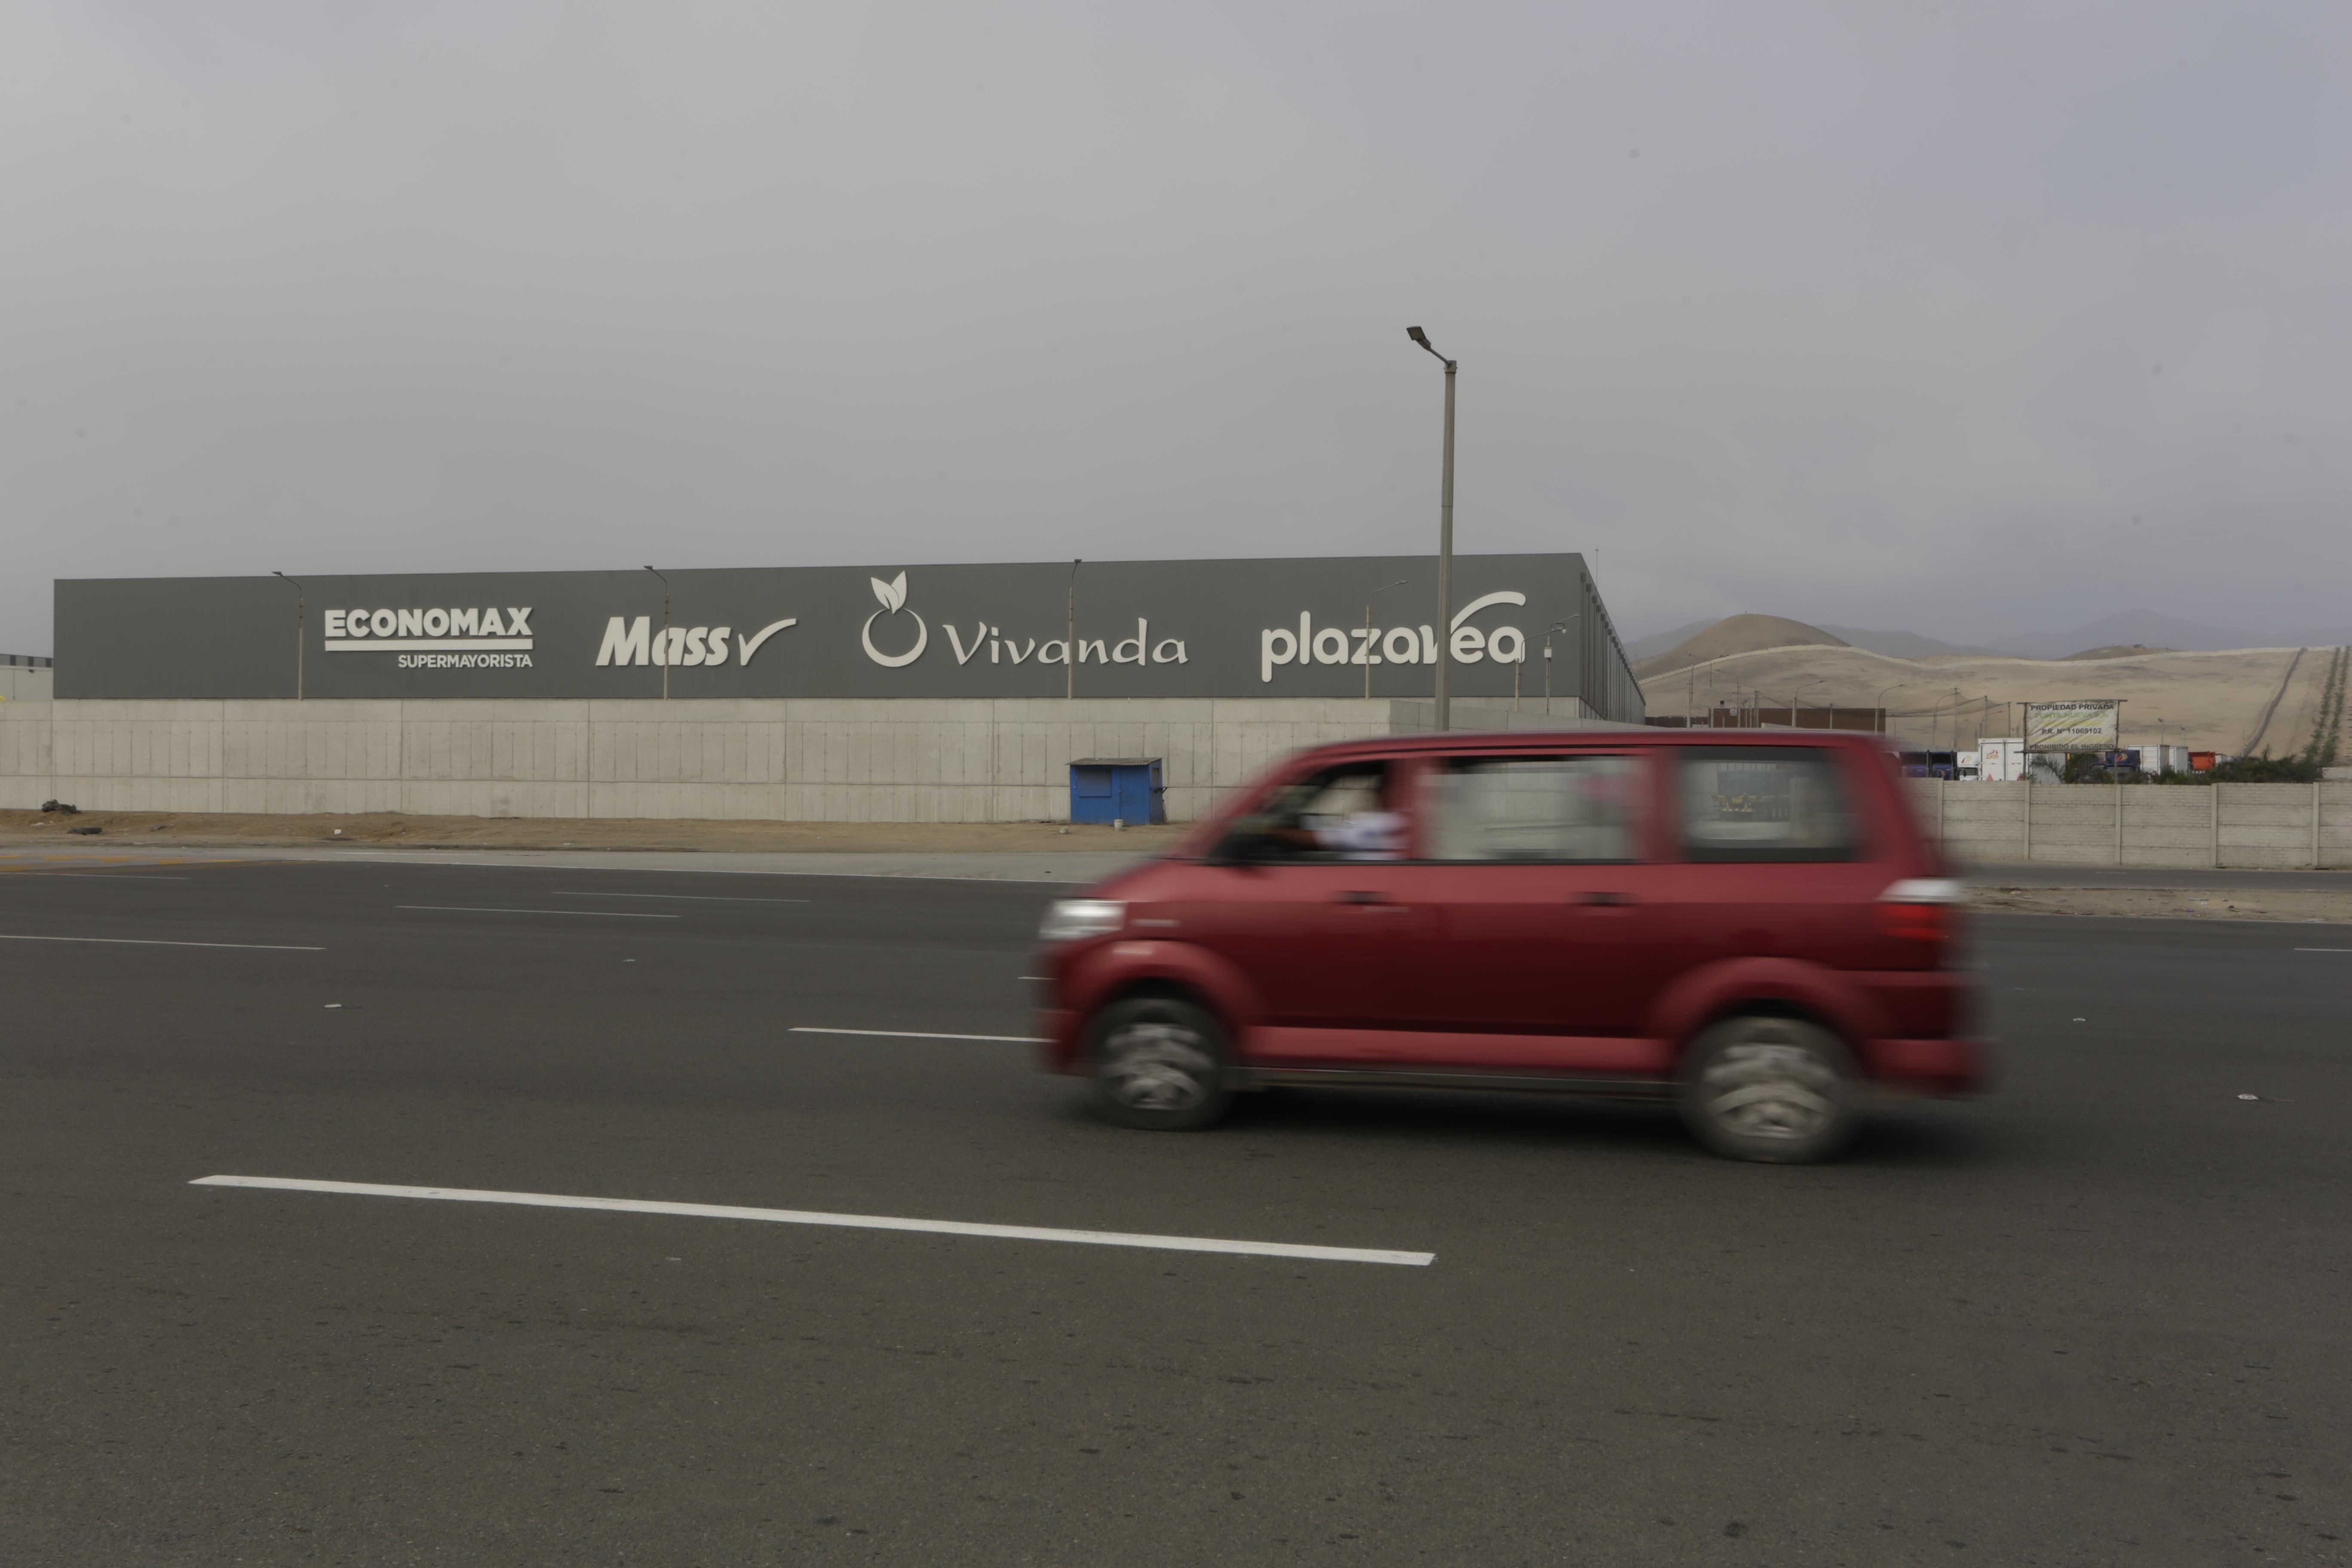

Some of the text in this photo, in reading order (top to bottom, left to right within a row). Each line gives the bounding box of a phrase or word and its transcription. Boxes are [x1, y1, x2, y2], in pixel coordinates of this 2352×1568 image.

[325, 607, 533, 637] ECONOMAX
[595, 616, 731, 666] Mass
[942, 618, 1188, 665] Vivanda
[398, 654, 533, 668] SUPERMAYORISTA
